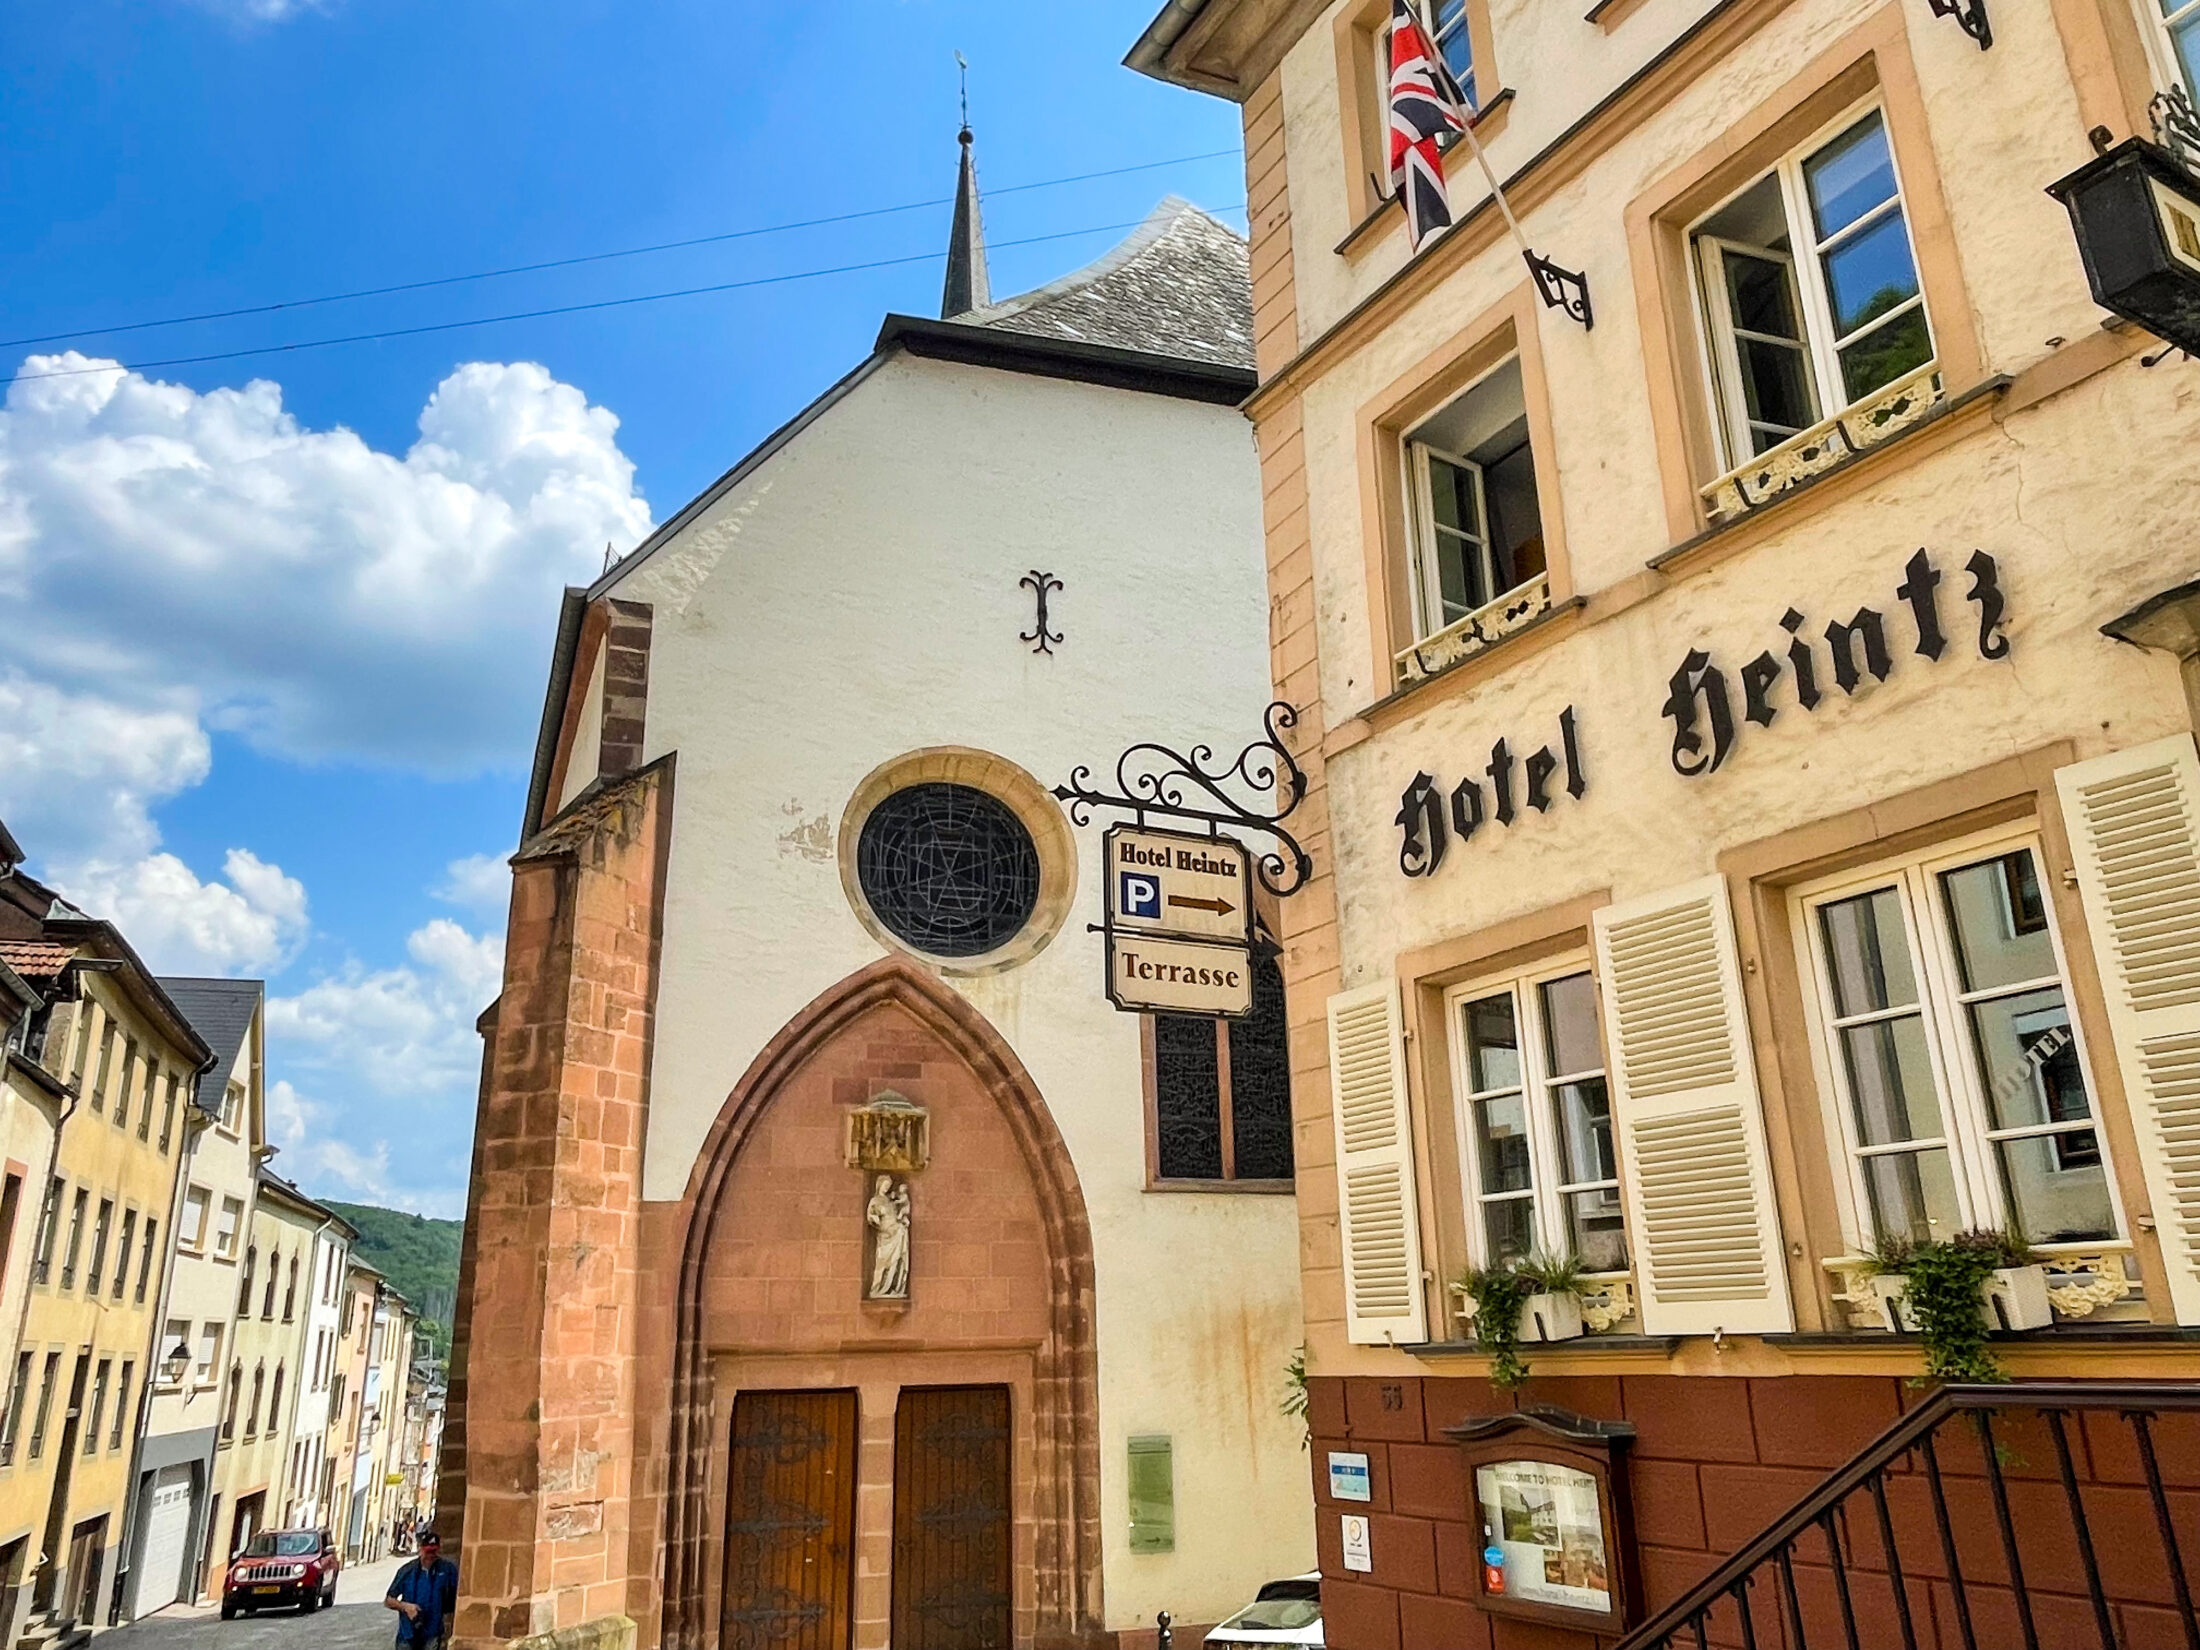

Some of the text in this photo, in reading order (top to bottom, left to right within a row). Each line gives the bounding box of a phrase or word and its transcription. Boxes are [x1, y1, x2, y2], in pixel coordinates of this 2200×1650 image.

[1395, 546, 2009, 878] Hotel Heintz
[1119, 842, 1237, 878] Hotel Heintz
[1127, 879, 1155, 912] P
[1121, 952, 1240, 988] Terrasse
